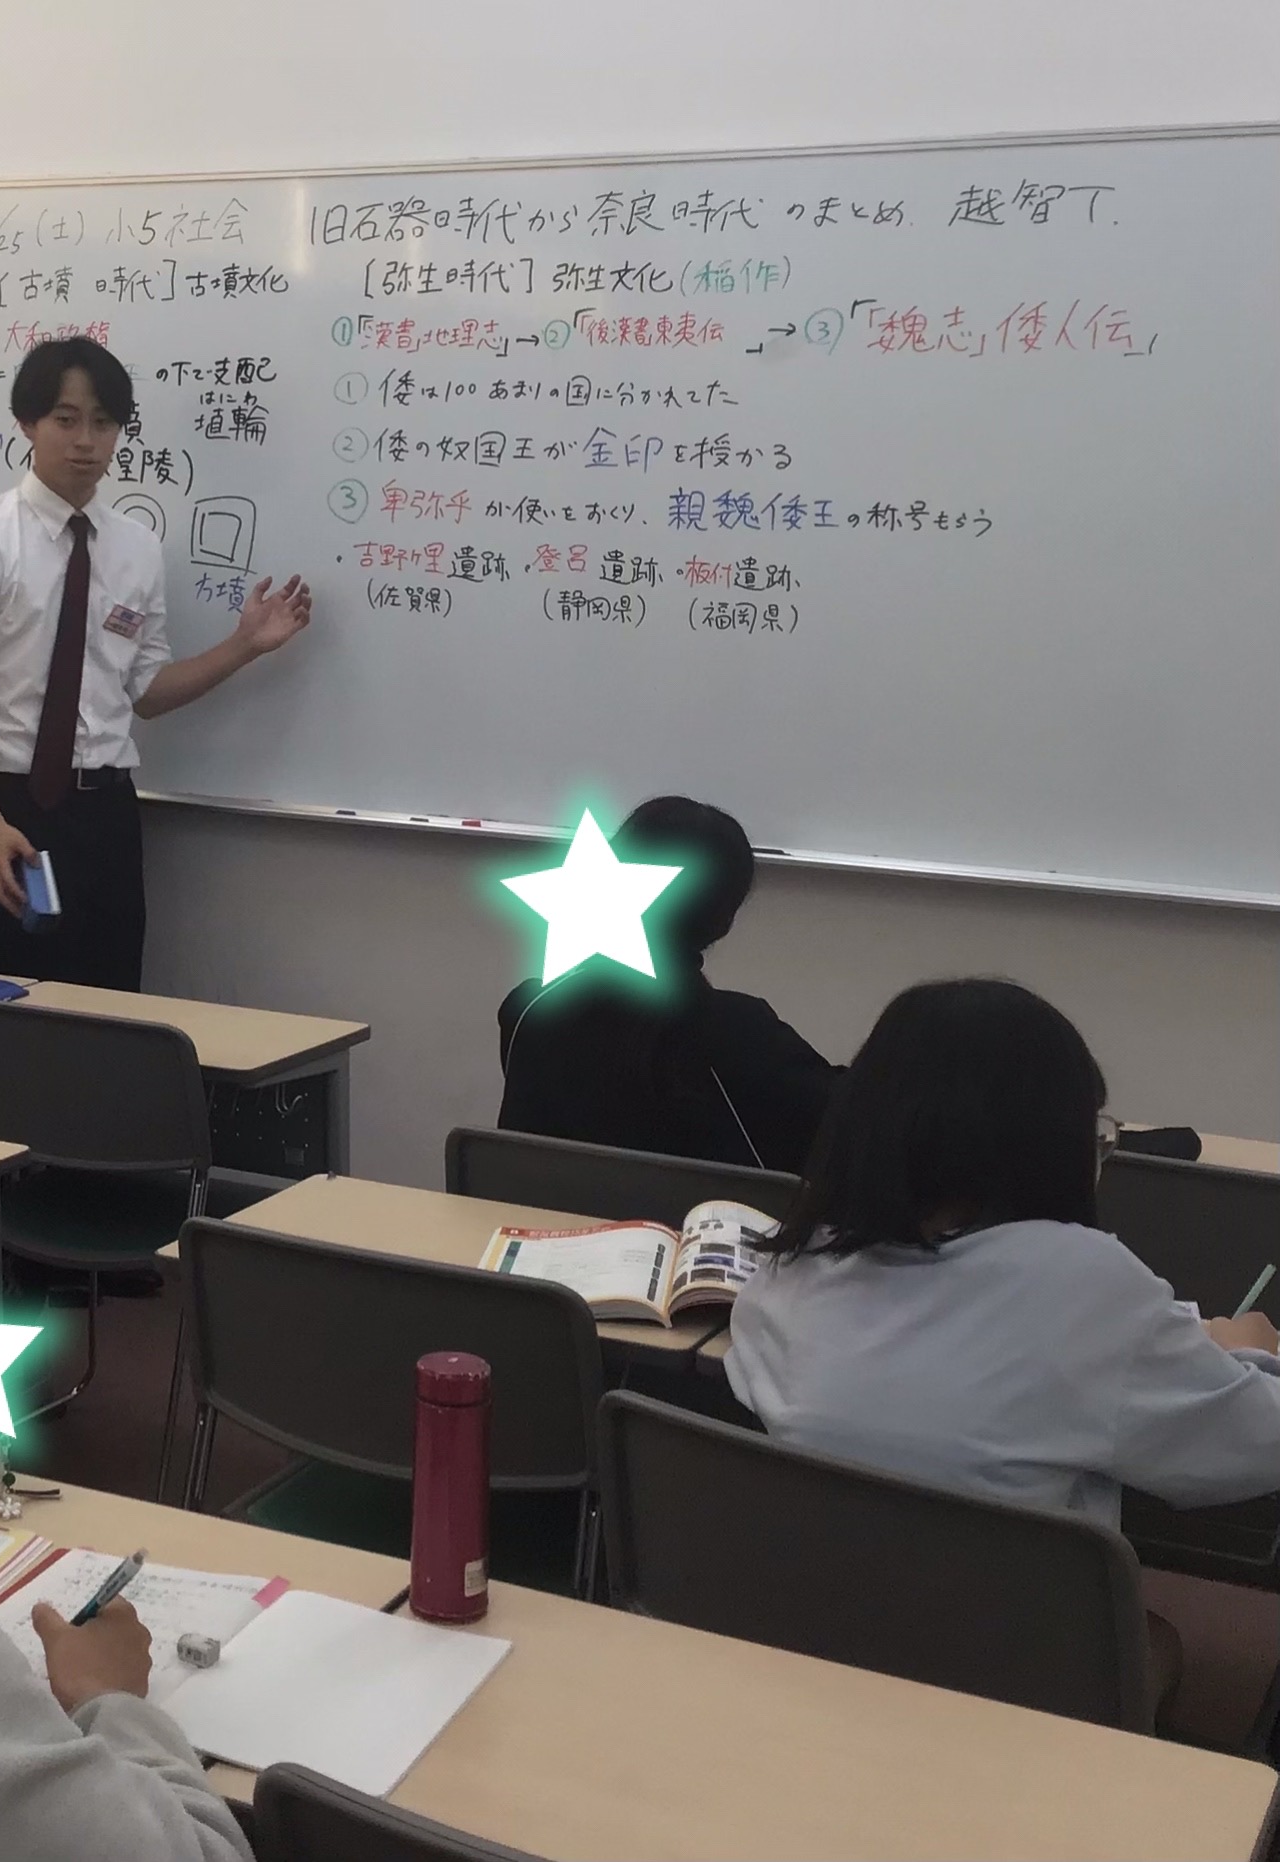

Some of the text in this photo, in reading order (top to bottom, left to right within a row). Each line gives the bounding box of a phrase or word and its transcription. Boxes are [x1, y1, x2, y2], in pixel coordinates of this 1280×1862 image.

[199, 391, 258, 406] はにわ
[194, 405, 270, 446] 埴輪
